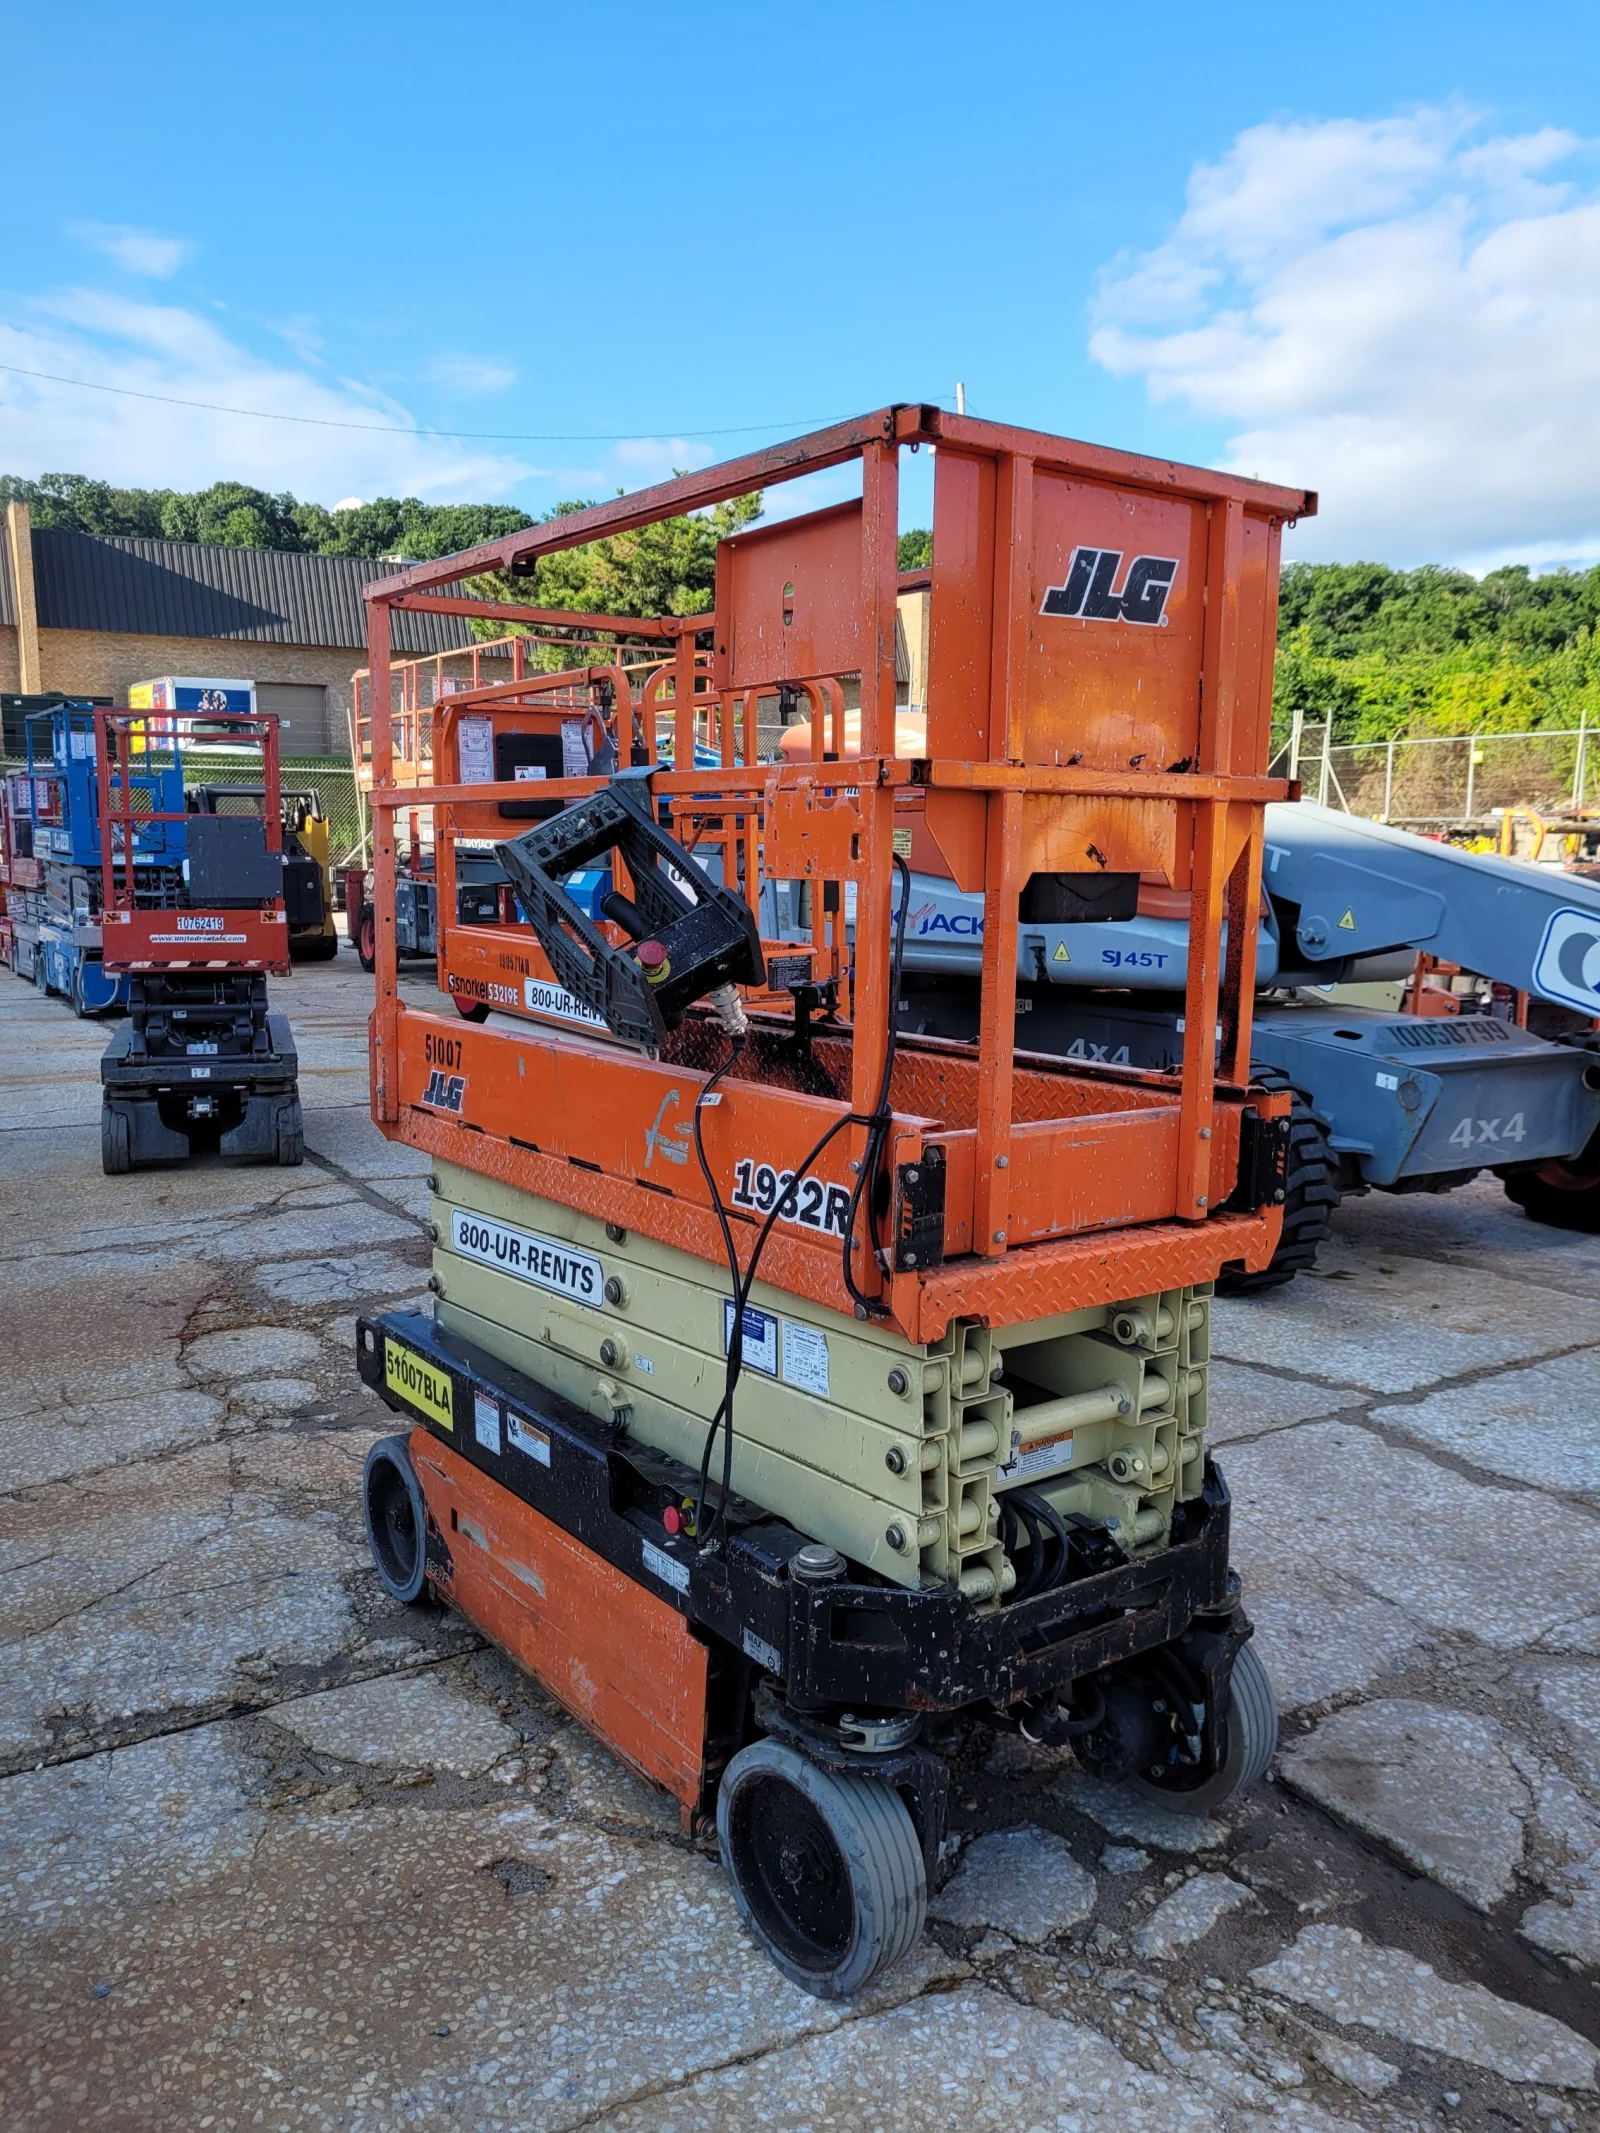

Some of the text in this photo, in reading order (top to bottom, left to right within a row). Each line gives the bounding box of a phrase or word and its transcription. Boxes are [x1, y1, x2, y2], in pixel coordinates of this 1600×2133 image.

[1038, 545, 1180, 627] JLG
[465, 838, 495, 851] SKYJACK
[893, 832, 910, 840] RNING
[177, 917, 223, 929] 10762419
[890, 902, 985, 935] KYJACK
[455, 977, 488, 1000] snorkel
[487, 983, 519, 1007] S3219E
[531, 987, 603, 1022] 800-UR-REN
[1389, 1020, 1511, 1048] 10058799
[425, 1033, 462, 1071] 51007
[422, 1069, 466, 1114] JLG
[732, 1160, 850, 1237] 1932R
[459, 1220, 594, 1294] 800-UR-RENTS
[387, 1349, 451, 1415] 51007BLA
[1033, 1433, 1065, 1447] WARNING
[747, 1632, 763, 1650] MAX
